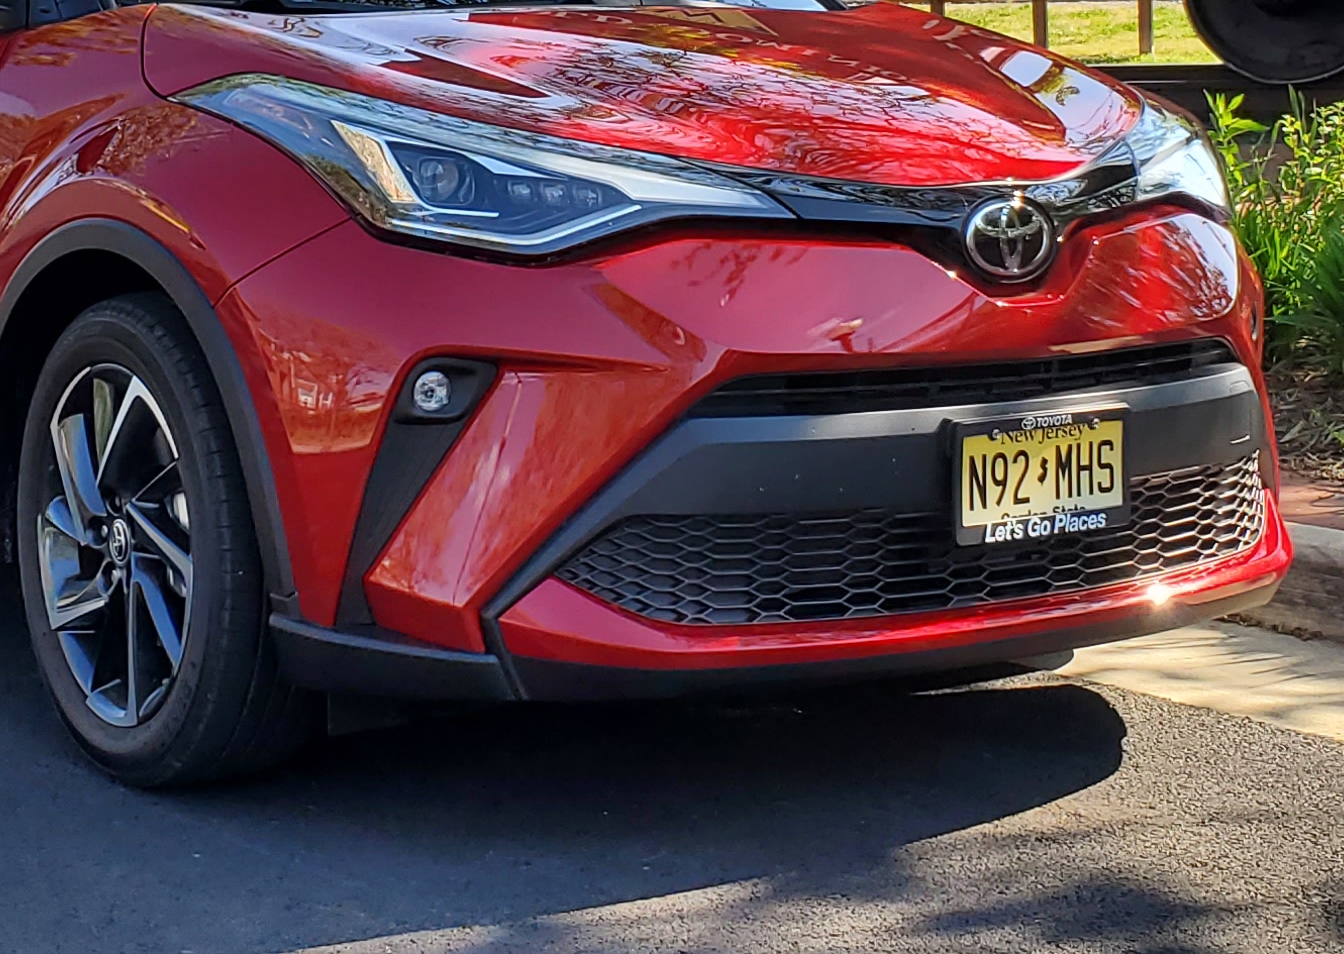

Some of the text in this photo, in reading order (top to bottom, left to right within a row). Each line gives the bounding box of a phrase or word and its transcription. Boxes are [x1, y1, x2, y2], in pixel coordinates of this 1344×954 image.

[1000, 423, 1085, 445] New Jersey
[1036, 414, 1073, 428] TOYOTA
[968, 439, 1115, 512] N92 MHS
[984, 519, 1024, 544] Let's
[1027, 517, 1052, 538] Go
[1053, 512, 1108, 535] Places
